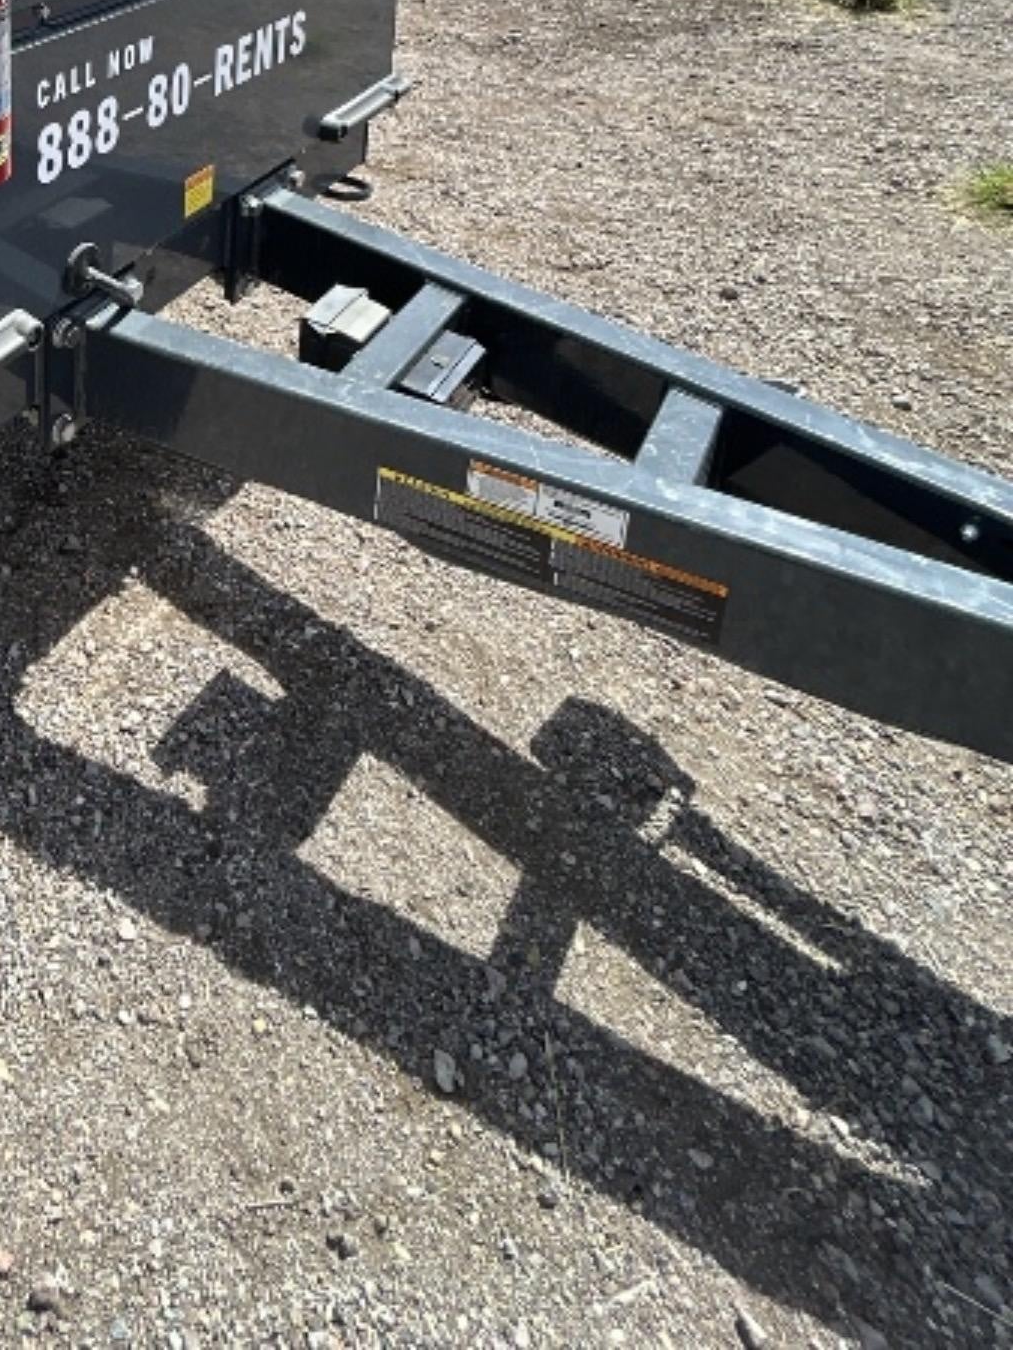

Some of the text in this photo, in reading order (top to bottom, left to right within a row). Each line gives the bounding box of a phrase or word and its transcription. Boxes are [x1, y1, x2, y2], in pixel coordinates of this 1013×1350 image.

[37, 61, 96, 109] CALL
[106, 35, 155, 79] NOW
[37, 7, 307, 184] 888-80-RENTS
